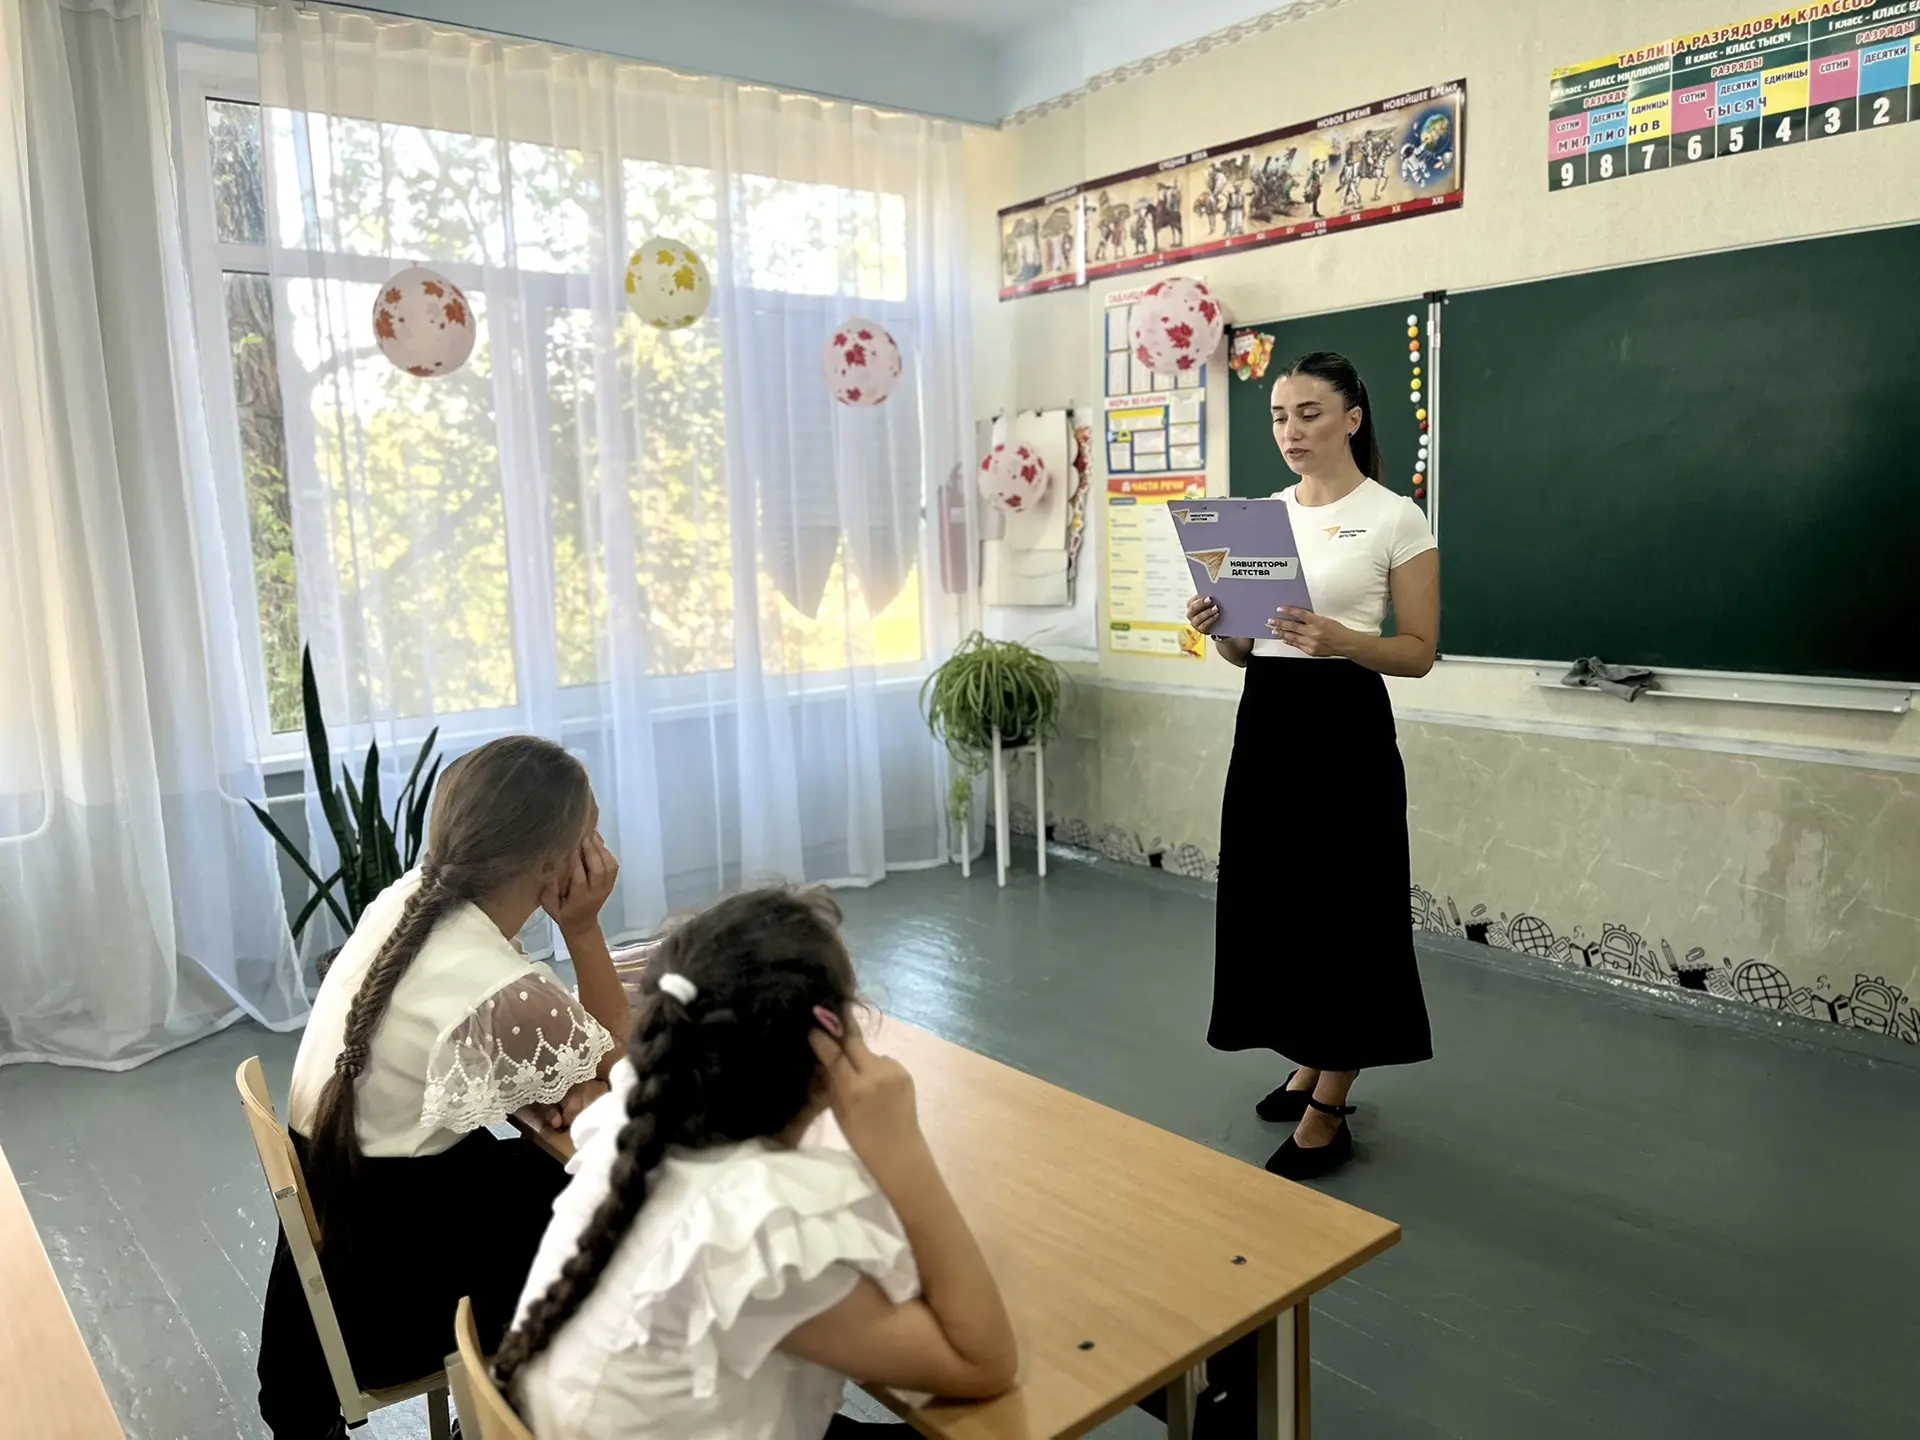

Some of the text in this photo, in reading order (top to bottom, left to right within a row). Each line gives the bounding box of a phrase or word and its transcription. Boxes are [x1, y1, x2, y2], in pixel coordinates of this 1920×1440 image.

[1835, 15, 1863, 31] класс
[1872, 3, 1907, 21] КЛАСС
[1692, 18, 1773, 47] РАЗРЯДОВ
[1780, 14, 1790, 27] И
[1857, 20, 1915, 44] РАЗРЯДЫ
[1694, 50, 1718, 63] класс
[1725, 41, 1756, 56] КЛАСС
[1758, 32, 1791, 48] ТЫСЯЧ
[1864, 46, 1907, 65] ДЕСЯТКИ
[1588, 76, 1615, 90] КЛАСС
[1617, 61, 1670, 82] МИЛЛИОНОВ
[1711, 58, 1763, 77] РАЗРЯДЫ
[1764, 69, 1808, 85] ЕДИНИЦЫ
[1820, 59, 1849, 73] СОТНИ
[1382, 83, 1458, 111] НОВЕЙШЕЕ ВРЕМЯ
[1680, 91, 1706, 103] СОТНИ
[1720, 80, 1757, 94] ДЕСЯТКИ
[1316, 106, 1371, 128] НОВОЕ ВРЕМЯ
[1592, 109, 1626, 124] ДЕСЯТКИ
[1631, 99, 1669, 115] ЕДИНИЦЫ
[1706, 96, 1767, 118] ТЫСЯЧ
[1873, 97, 1890, 125] 2
[1556, 120, 1580, 132] СОТНИ
[1775, 116, 1791, 142] 4
[1824, 107, 1840, 134] 3
[1558, 119, 1660, 151] МИЛЛИОНОВ
[1729, 126, 1744, 152] 5
[1641, 144, 1655, 169] 7
[1687, 135, 1702, 160] 6
[1560, 162, 1574, 187] 9
[1600, 154, 1613, 178] 8
[1229, 560, 1288, 568] НАВИГАТОРЫ
[1231, 568, 1270, 576] ДЕТСТВА
